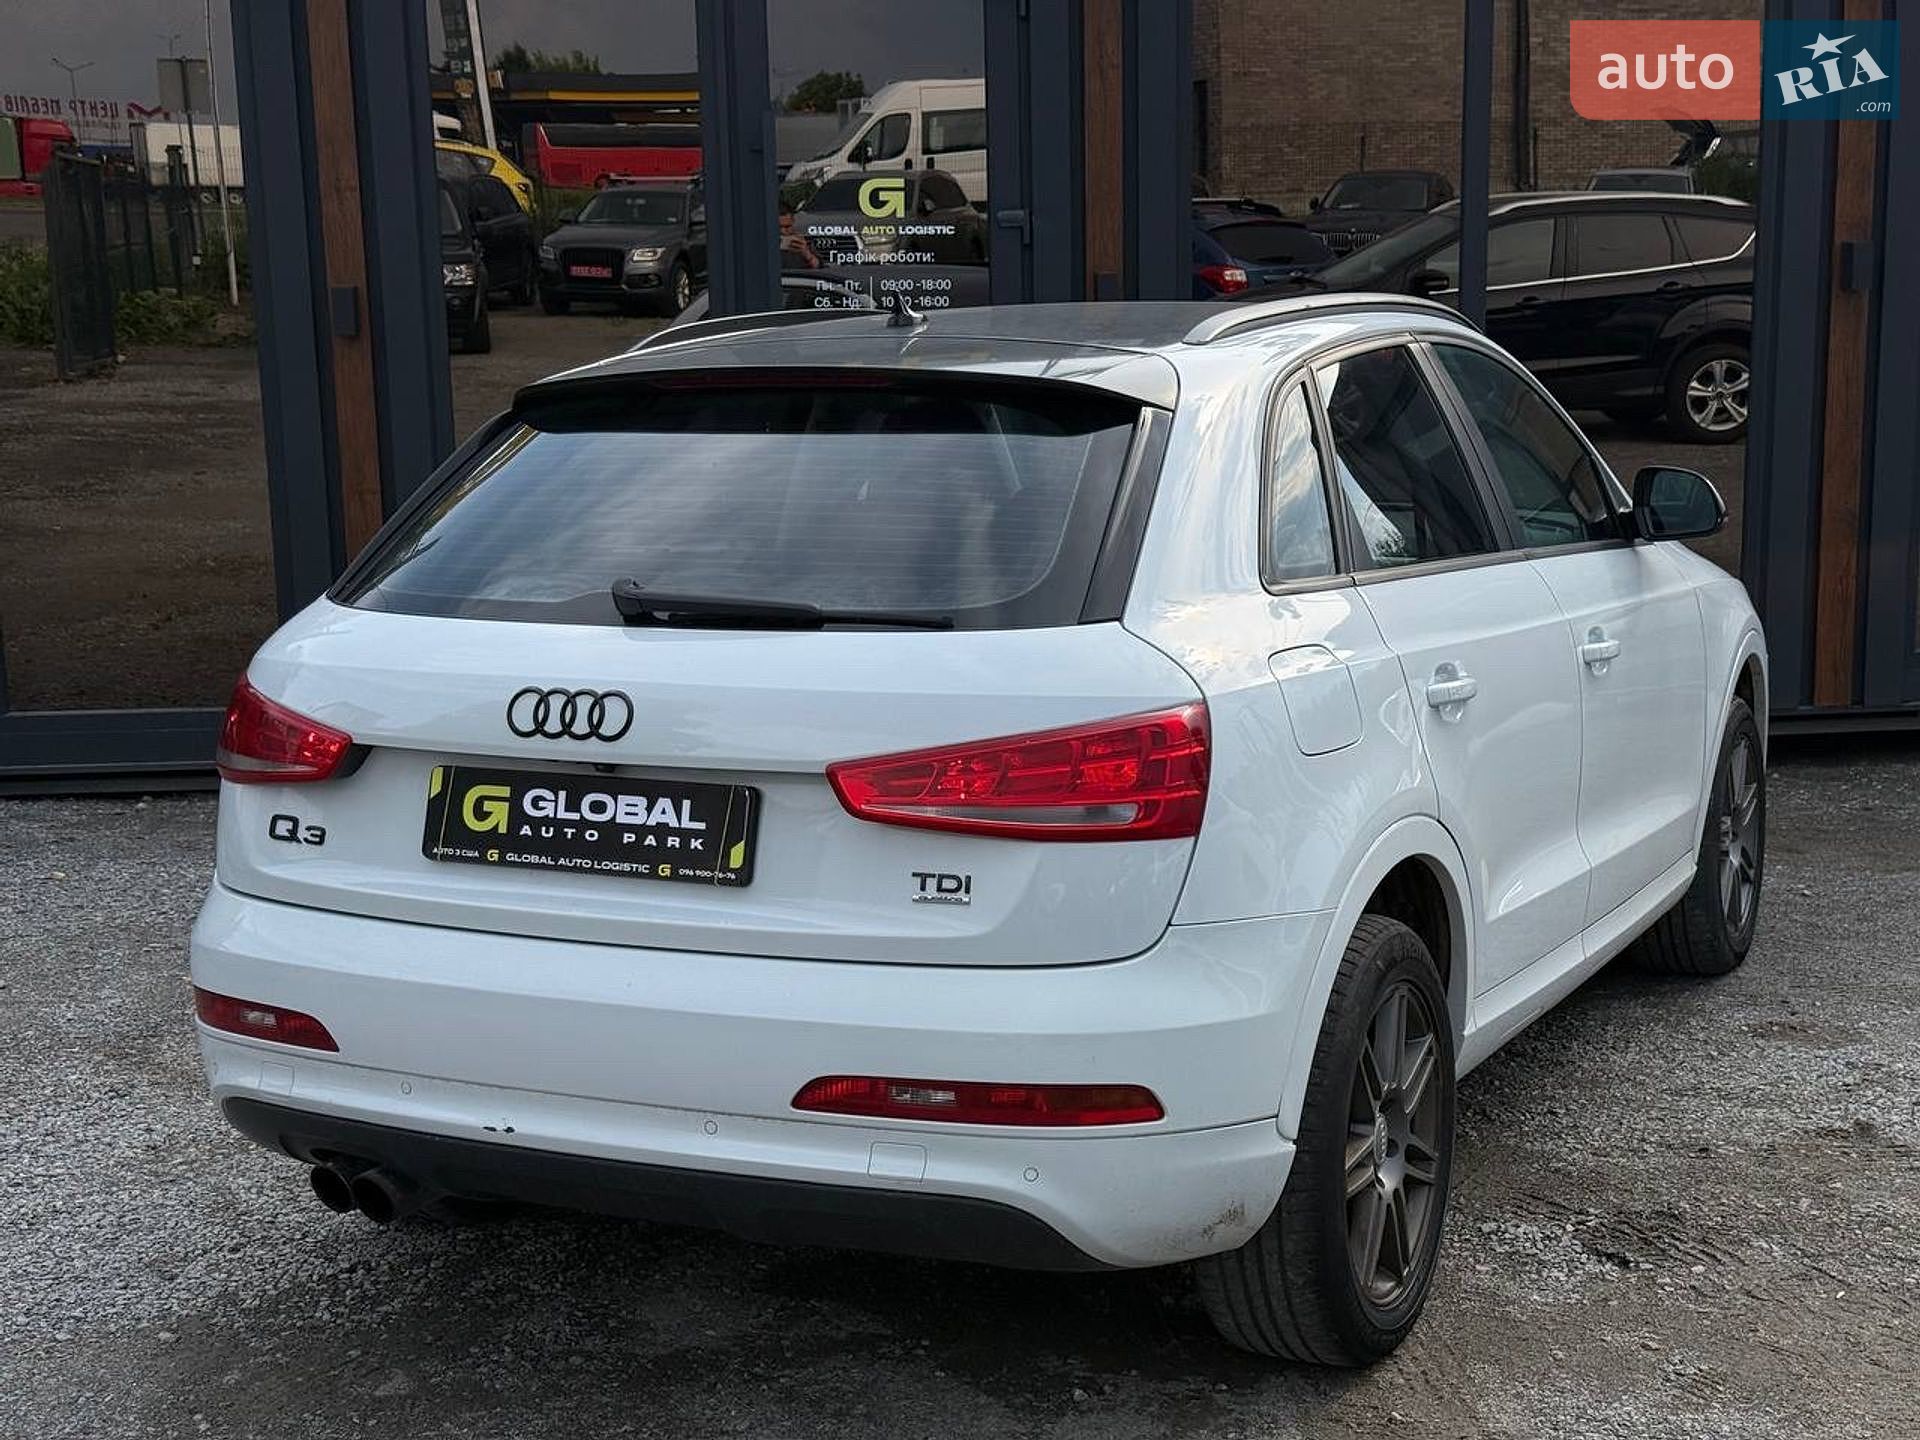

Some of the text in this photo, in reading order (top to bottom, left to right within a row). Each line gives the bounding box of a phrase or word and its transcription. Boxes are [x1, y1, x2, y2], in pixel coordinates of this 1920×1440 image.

[808, 226, 956, 235] GLOBAL AUTO LOGISTIC
[829, 250, 935, 264] Графік роботи:
[845, 280, 863, 291] Пт.
[814, 297, 833, 307] Сб.
[522, 788, 706, 830] GLOBAL
[269, 814, 327, 846] Q3
[519, 825, 705, 850] AUTO PARK
[505, 853, 555, 865] GLOBAL
[557, 857, 592, 869] AUTO
[594, 860, 650, 873] LOGISTIC
[912, 872, 972, 894] TDI
